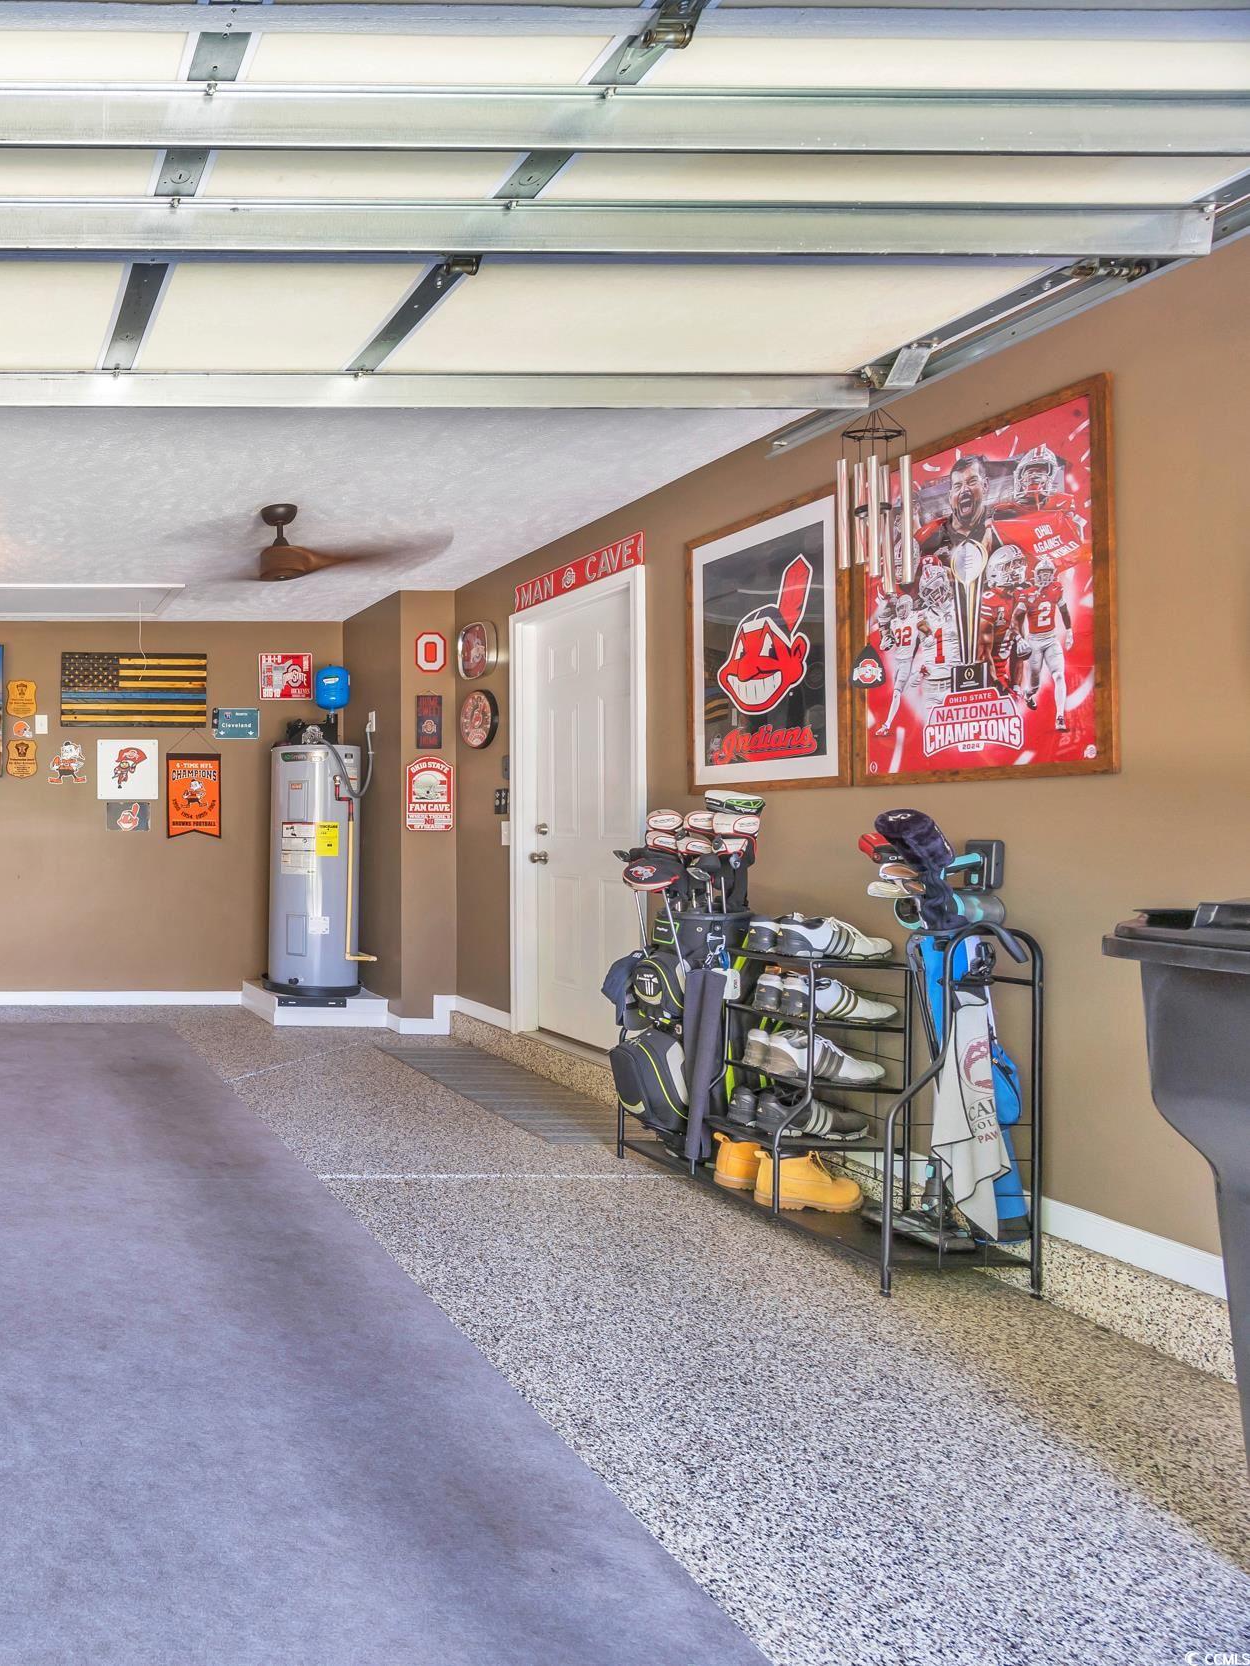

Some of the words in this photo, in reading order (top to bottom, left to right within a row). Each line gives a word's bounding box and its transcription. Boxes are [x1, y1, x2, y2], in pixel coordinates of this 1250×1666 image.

[1034, 524, 1053, 539] OHIO
[1033, 535, 1064, 553] AGAINST
[520, 574, 554, 608] MAN
[585, 538, 635, 581] CAVE
[1037, 601, 1052, 627] 2
[894, 626, 912, 647] 32
[934, 628, 945, 663] 1
[969, 692, 992, 701] STATE
[936, 703, 1006, 722] NATIONAL
[713, 724, 817, 766] Indians
[925, 717, 1021, 755] CHAMPIONS
[172, 769, 217, 782] CHAMPIONS
[410, 762, 427, 774] OHIO
[427, 761, 450, 774] STATE
[409, 803, 427, 811] FAN
[427, 803, 451, 811] CAVE
